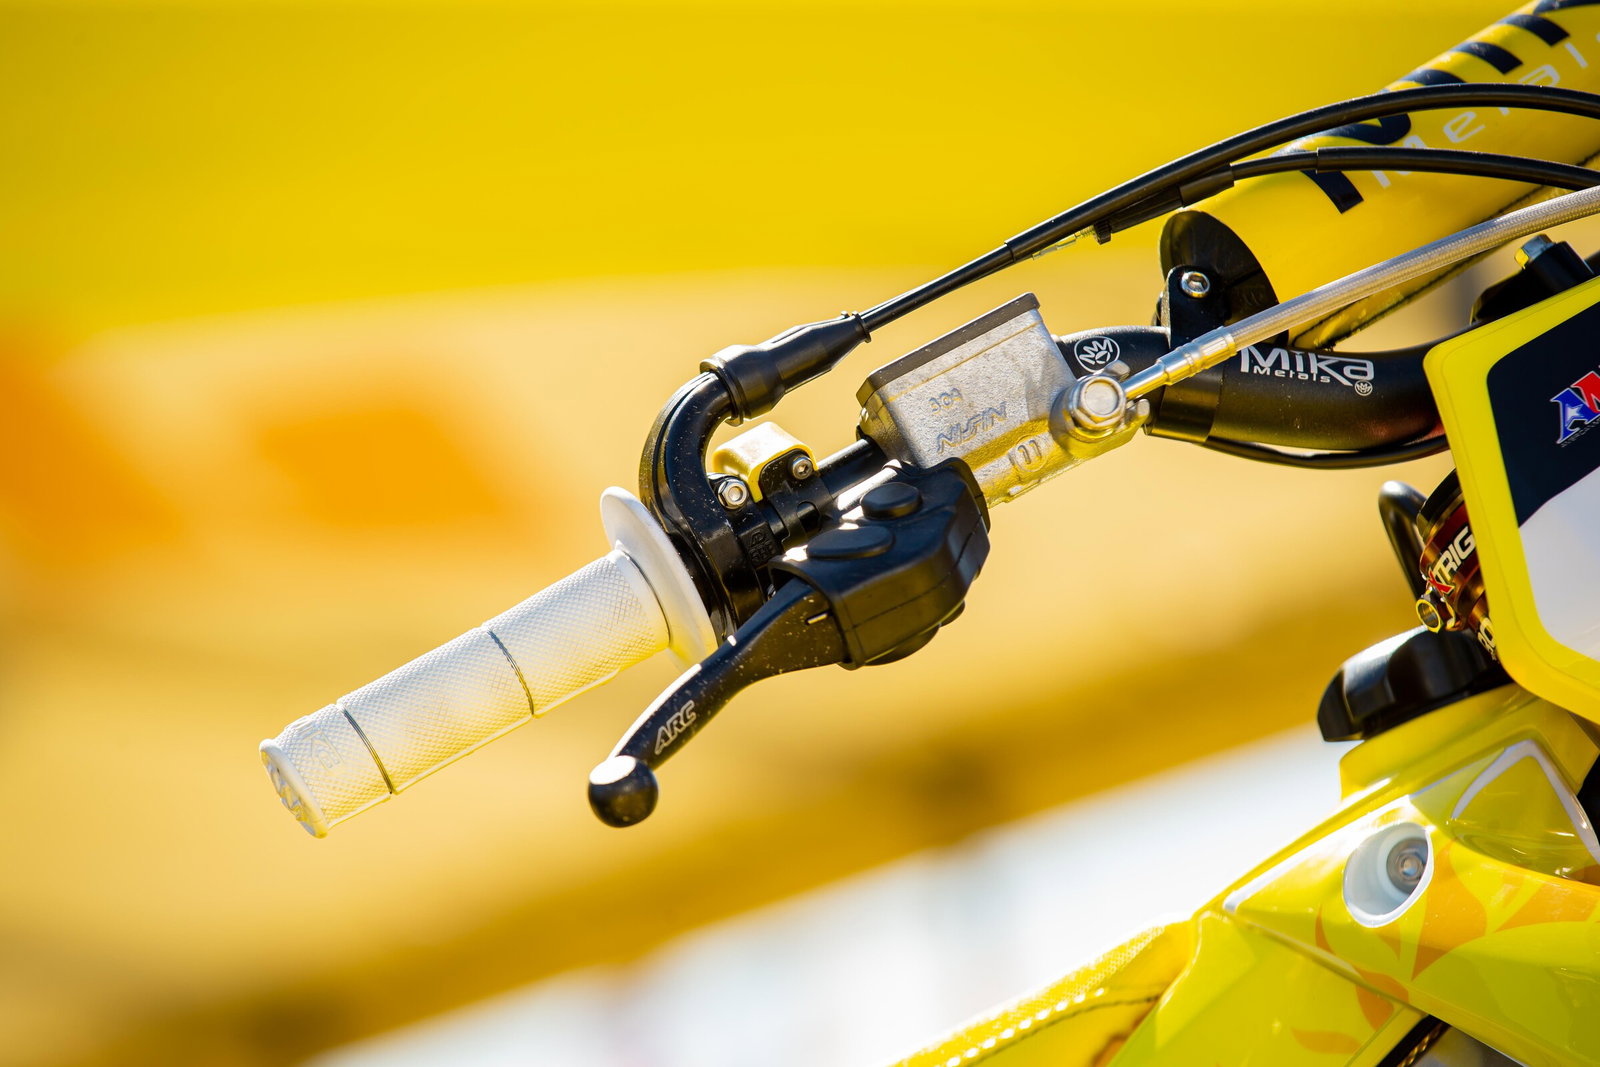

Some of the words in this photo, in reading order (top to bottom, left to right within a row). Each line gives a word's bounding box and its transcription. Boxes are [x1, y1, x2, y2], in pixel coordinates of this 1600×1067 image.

[1240, 345, 1375, 387] Mika
[1252, 365, 1331, 383] Metals
[1427, 525, 1477, 595] XTRIG
[654, 699, 697, 755] ARC
